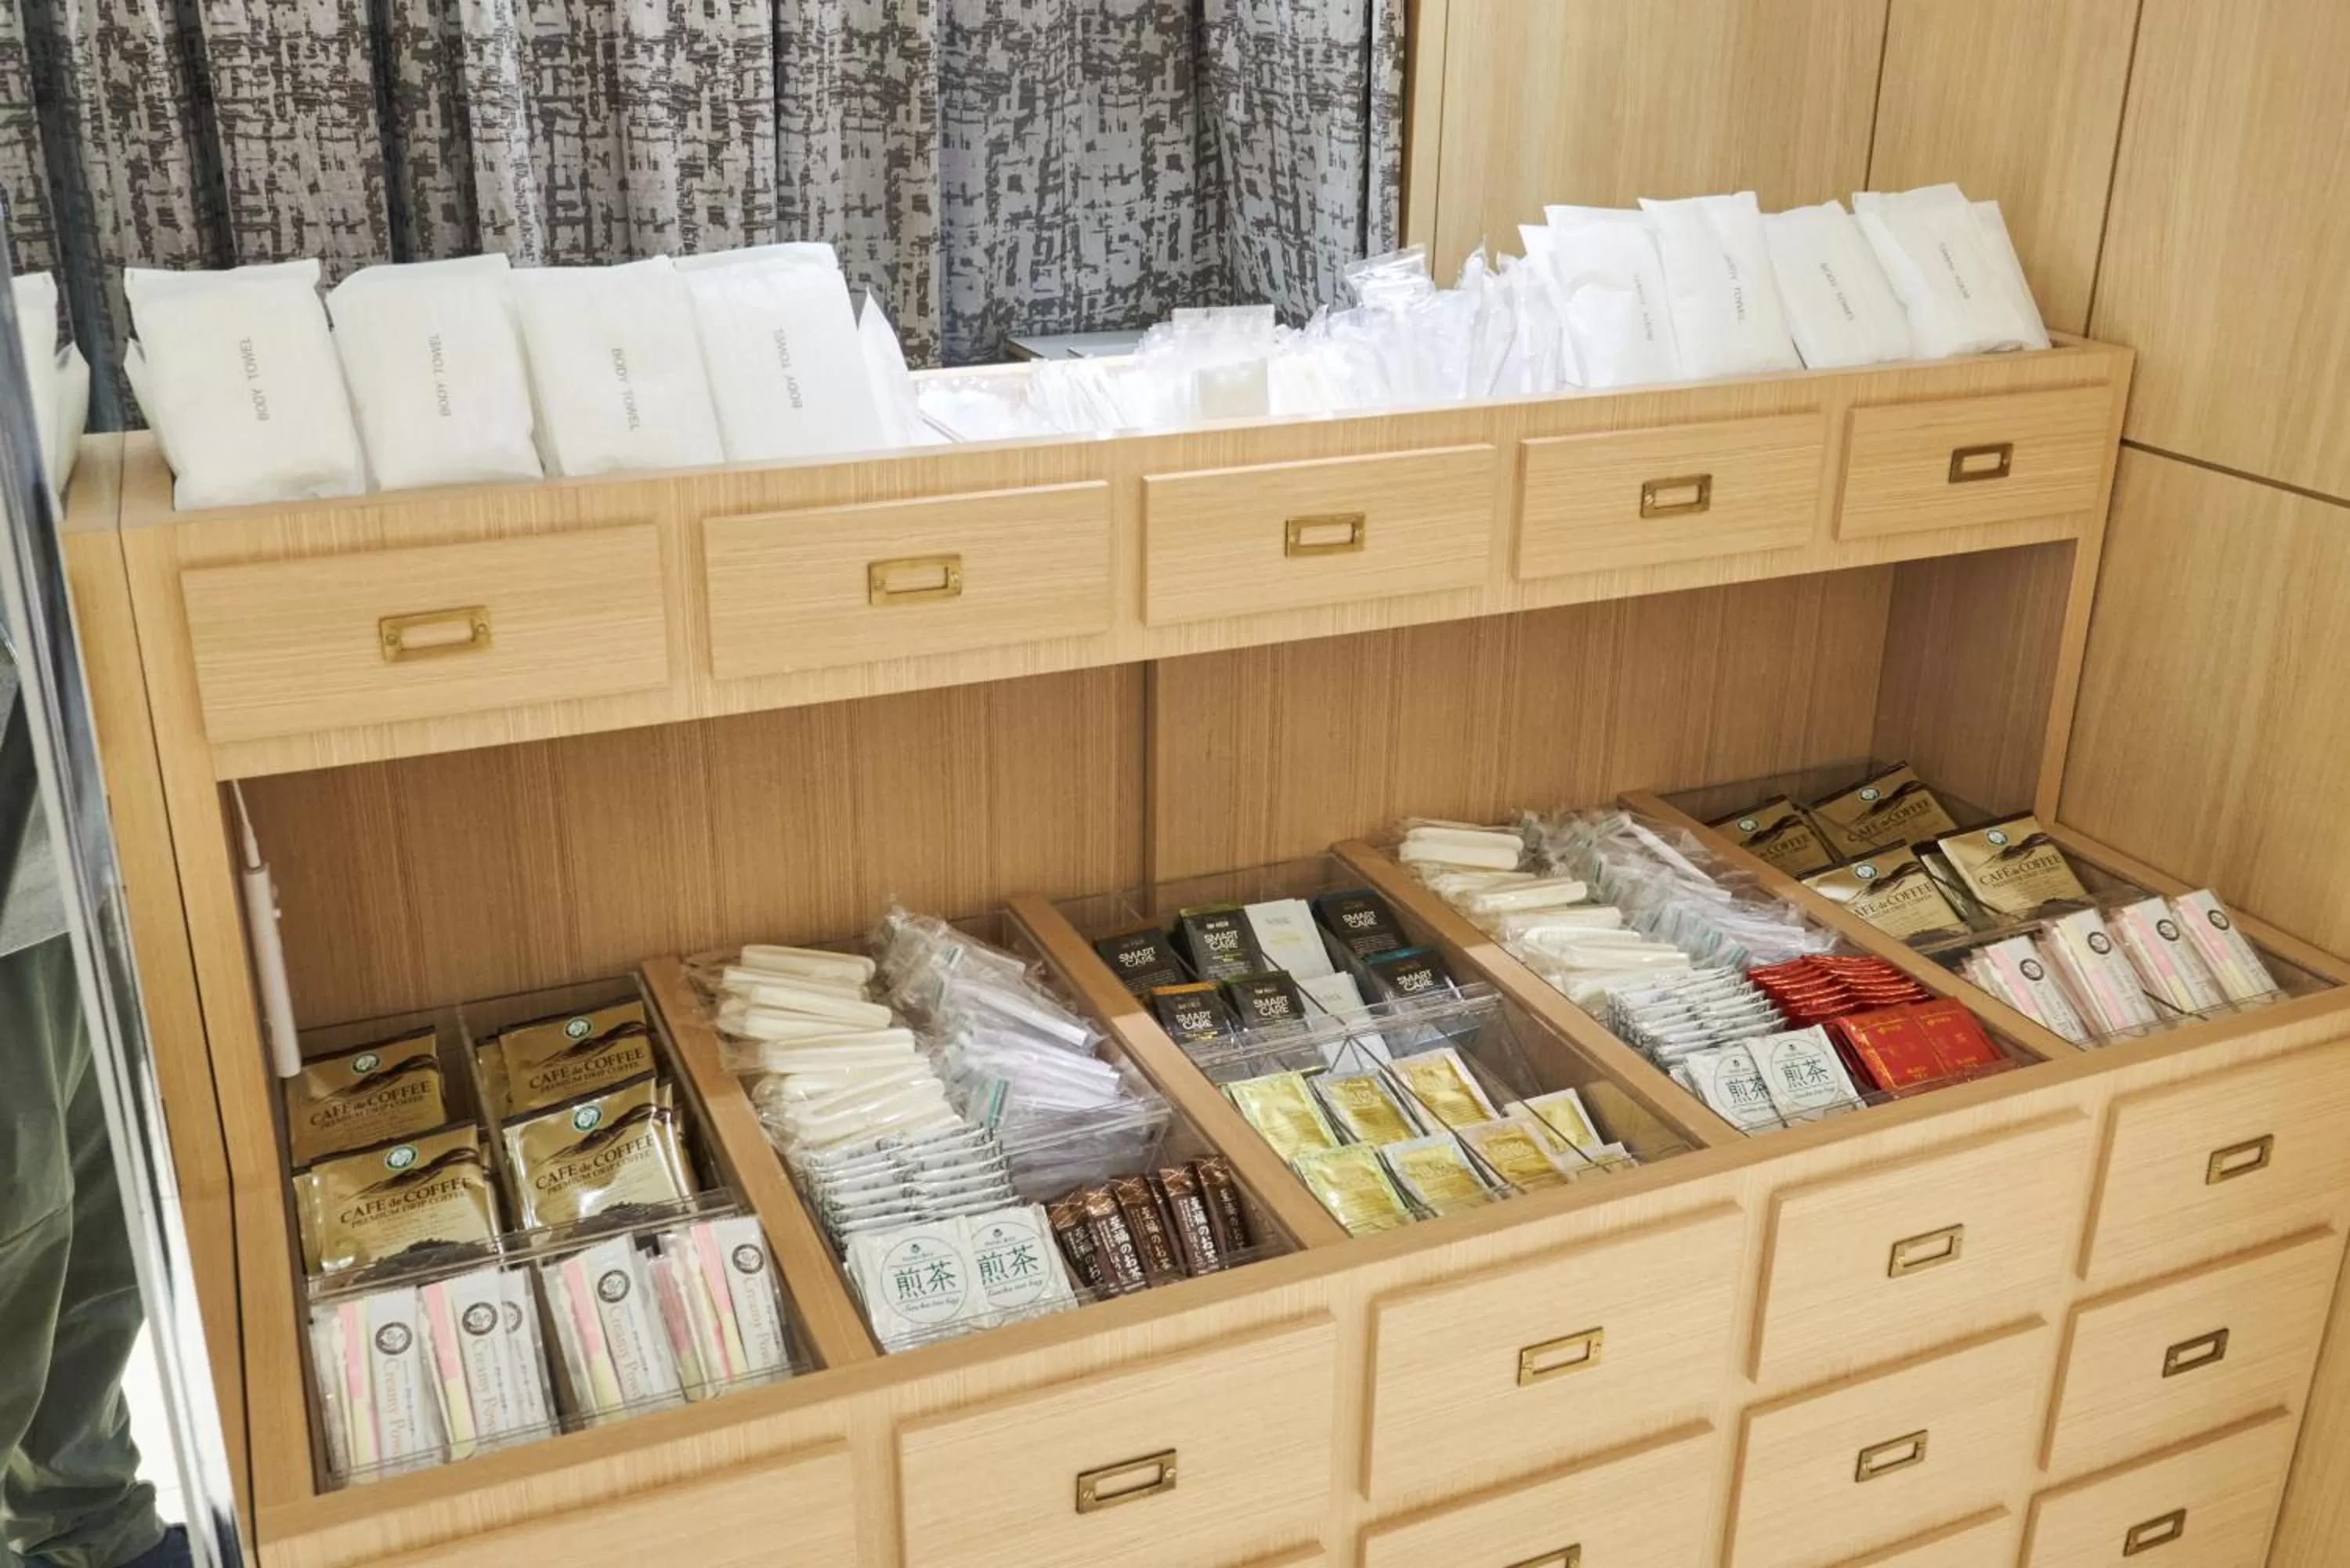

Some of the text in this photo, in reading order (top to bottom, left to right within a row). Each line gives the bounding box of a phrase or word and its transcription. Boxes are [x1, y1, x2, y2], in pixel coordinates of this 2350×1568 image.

[239, 337, 270, 421] BODY TOWEL
[1204, 930, 1238, 944] SMART
[1253, 995, 1289, 1010] SMART
[530, 1067, 568, 1089] CAFE
[584, 1046, 644, 1071] COFFEE
[1781, 1057, 1828, 1089] 煎茶
[309, 1102, 351, 1125] CAFE
[367, 1080, 433, 1106] COFFEE
[536, 1164, 578, 1190] CAFE
[593, 1134, 654, 1167] COFFEE
[341, 1199, 385, 1224] CAFE
[403, 1176, 472, 1202] COFFEE
[893, 1259, 956, 1300] 煎茶
[977, 1244, 1039, 1286] 煎茶
